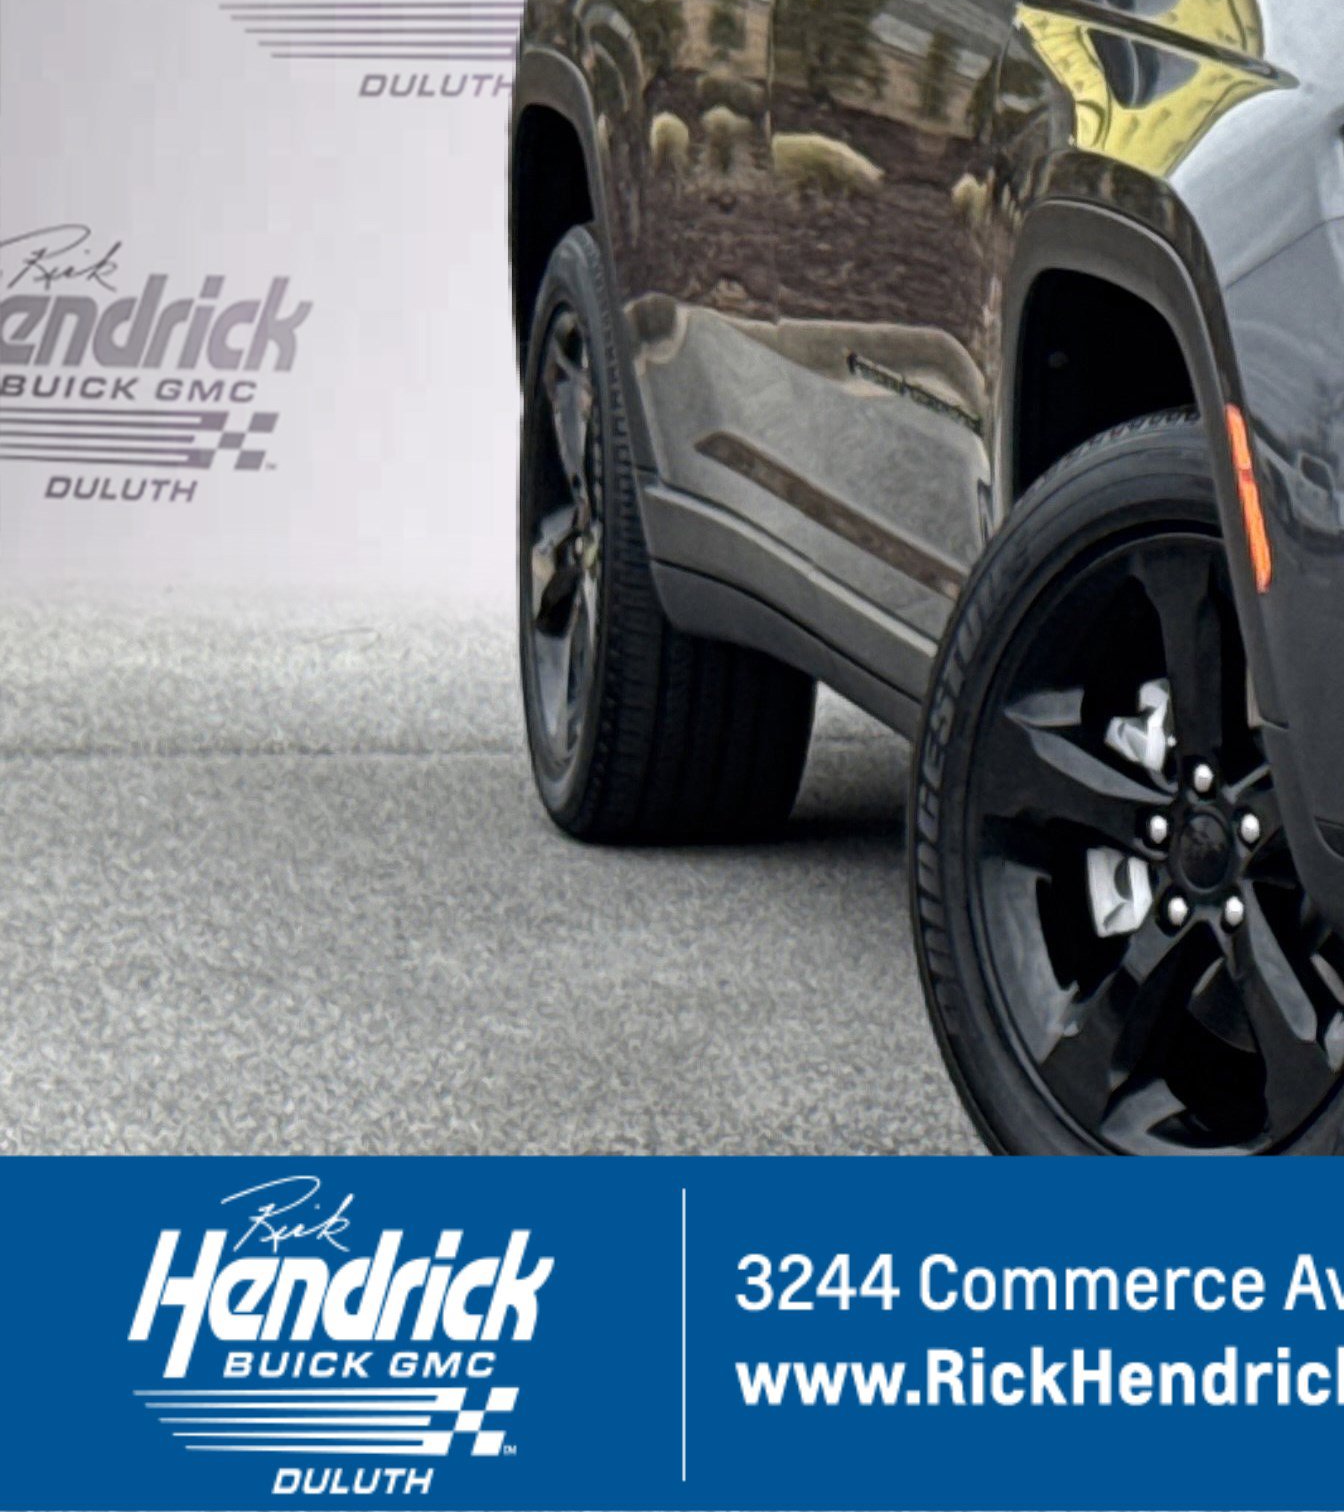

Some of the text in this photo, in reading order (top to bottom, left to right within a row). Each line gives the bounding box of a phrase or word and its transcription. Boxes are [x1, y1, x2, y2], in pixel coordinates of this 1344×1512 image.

[0, 273, 314, 373] endrick
[0, 374, 257, 404] BUICK GMC
[44, 475, 198, 503] DULUTH
[914, 556, 1008, 1038] BRIDGESTO
